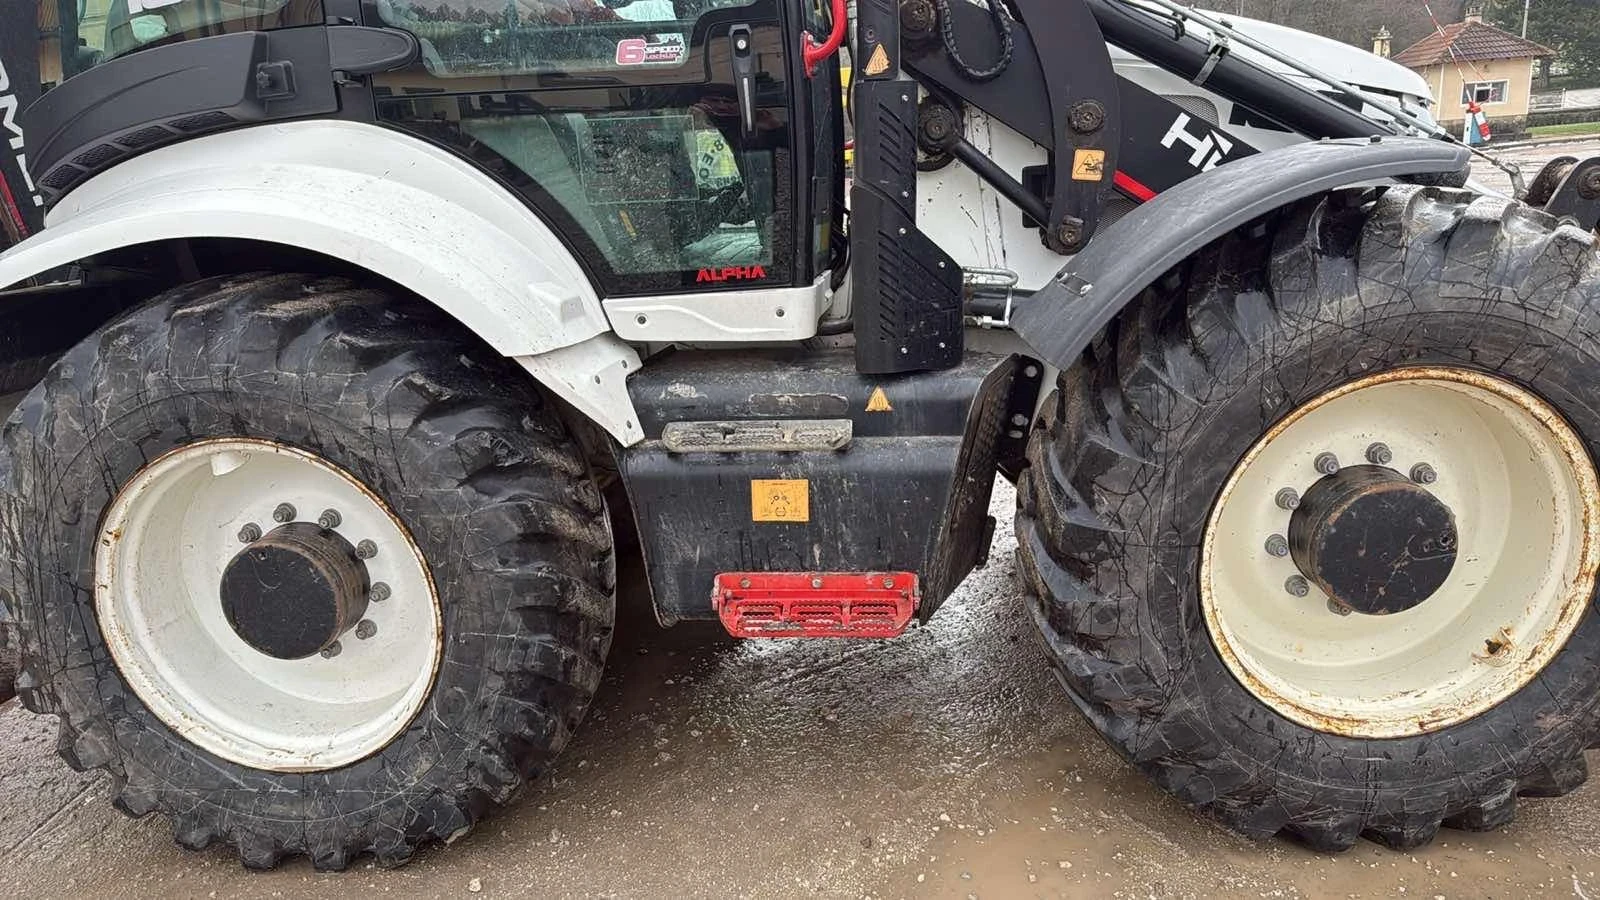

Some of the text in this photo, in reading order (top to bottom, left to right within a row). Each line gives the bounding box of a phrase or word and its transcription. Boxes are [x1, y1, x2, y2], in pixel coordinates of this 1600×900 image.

[616, 39, 680, 65] 6 SPEED
[696, 264, 768, 282] ALPHA
